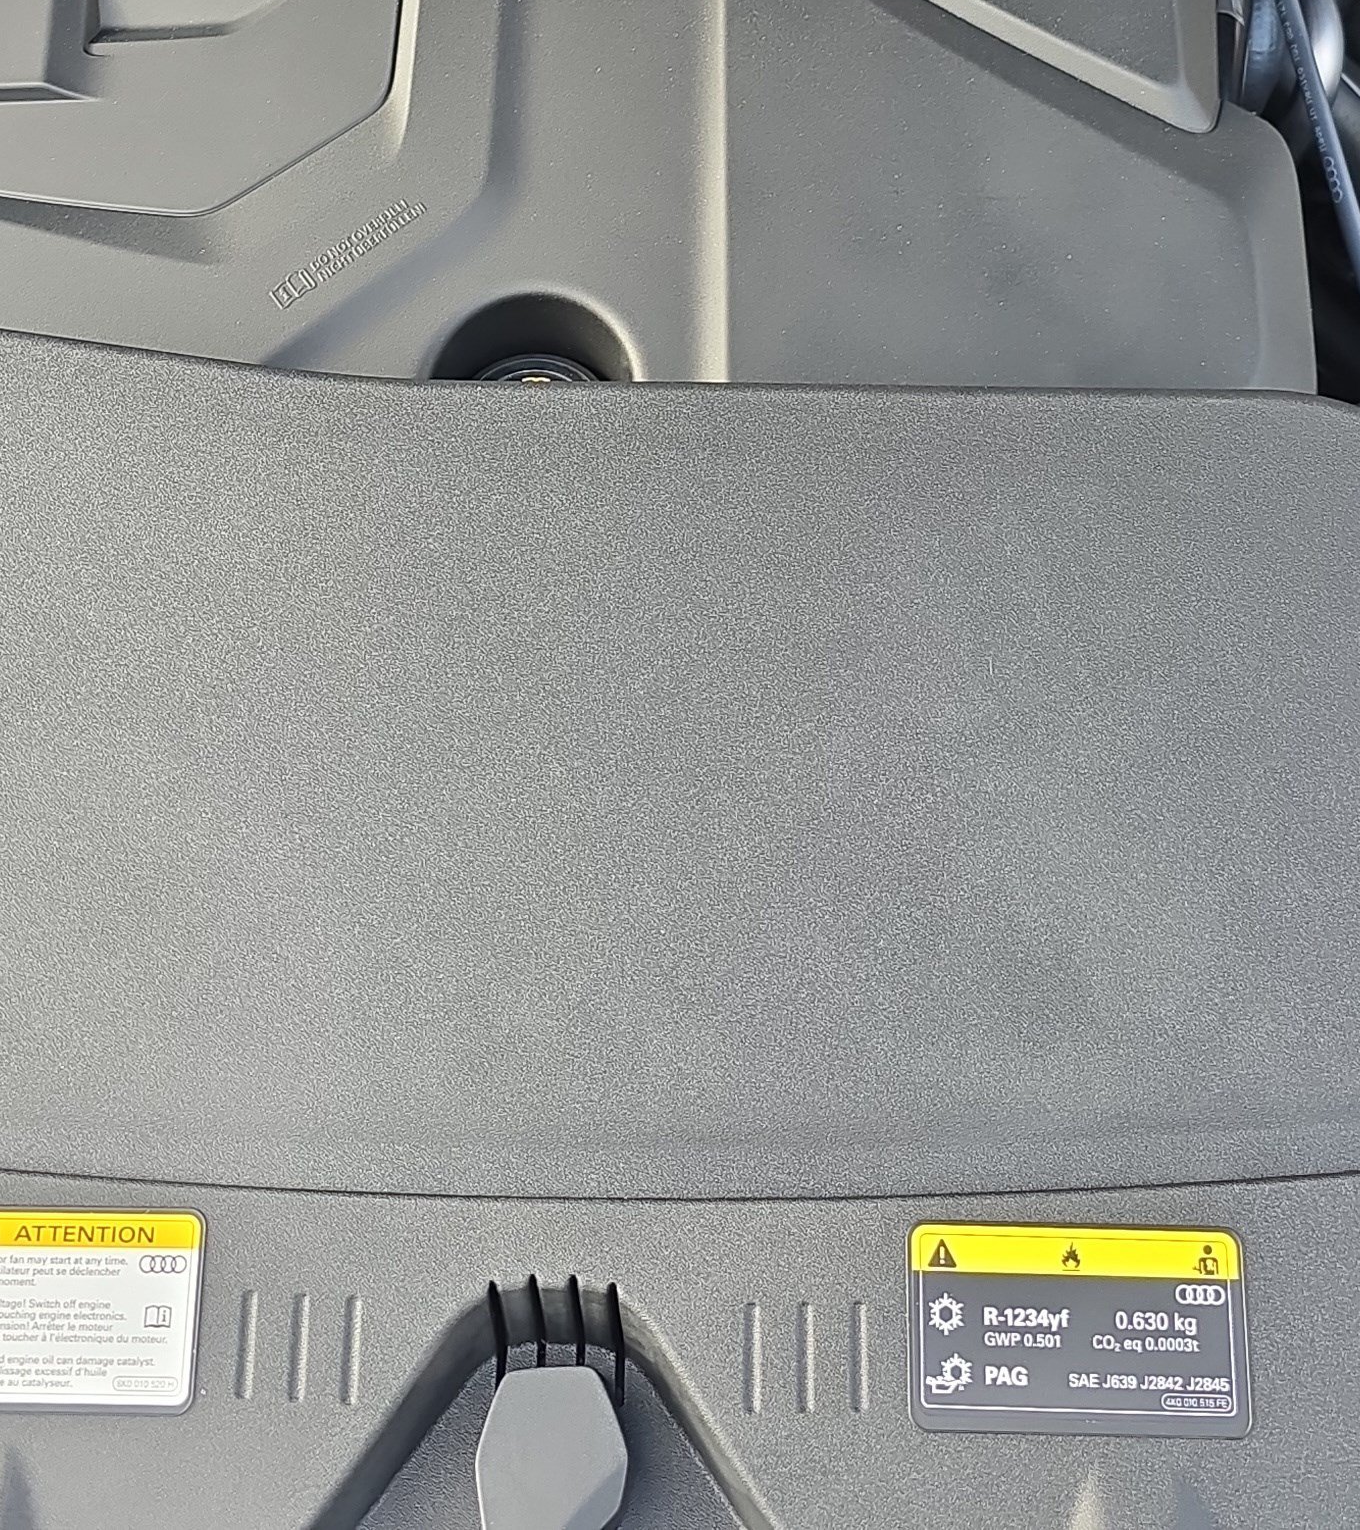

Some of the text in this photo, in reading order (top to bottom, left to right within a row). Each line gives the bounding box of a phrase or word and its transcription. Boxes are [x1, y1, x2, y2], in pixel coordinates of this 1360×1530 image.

[15, 1226, 155, 1243] ATTENTION
[10, 1255, 24, 1264] fan
[27, 1256, 46, 1265] may
[74, 1257, 83, 1265] at
[86, 1258, 101, 1266] any
[32, 1268, 53, 1276] peut
[29, 1299, 60, 1308] Switch
[63, 1300, 76, 1309] off
[78, 1301, 111, 1310] engine
[39, 1312, 70, 1321] engine
[983, 1307, 1070, 1331] R-1234yf
[67, 1323, 76, 1331] le
[1116, 1312, 1197, 1335] 0.630 kg
[3, 1334, 38, 1342] toucher
[117, 1335, 129, 1343] du
[984, 1332, 1061, 1348] GWP 0.501
[1124, 1339, 1143, 1352] eq
[1145, 1338, 1199, 1352] 0.0003t
[7, 1356, 40, 1366] engine
[42, 1356, 53, 1365] oil
[76, 1357, 114, 1367] damage
[35, 1367, 72, 1376] excessif
[985, 1366, 1028, 1386] PAG
[1069, 1374, 1229, 1392] SAE J639 J2842 J2845
